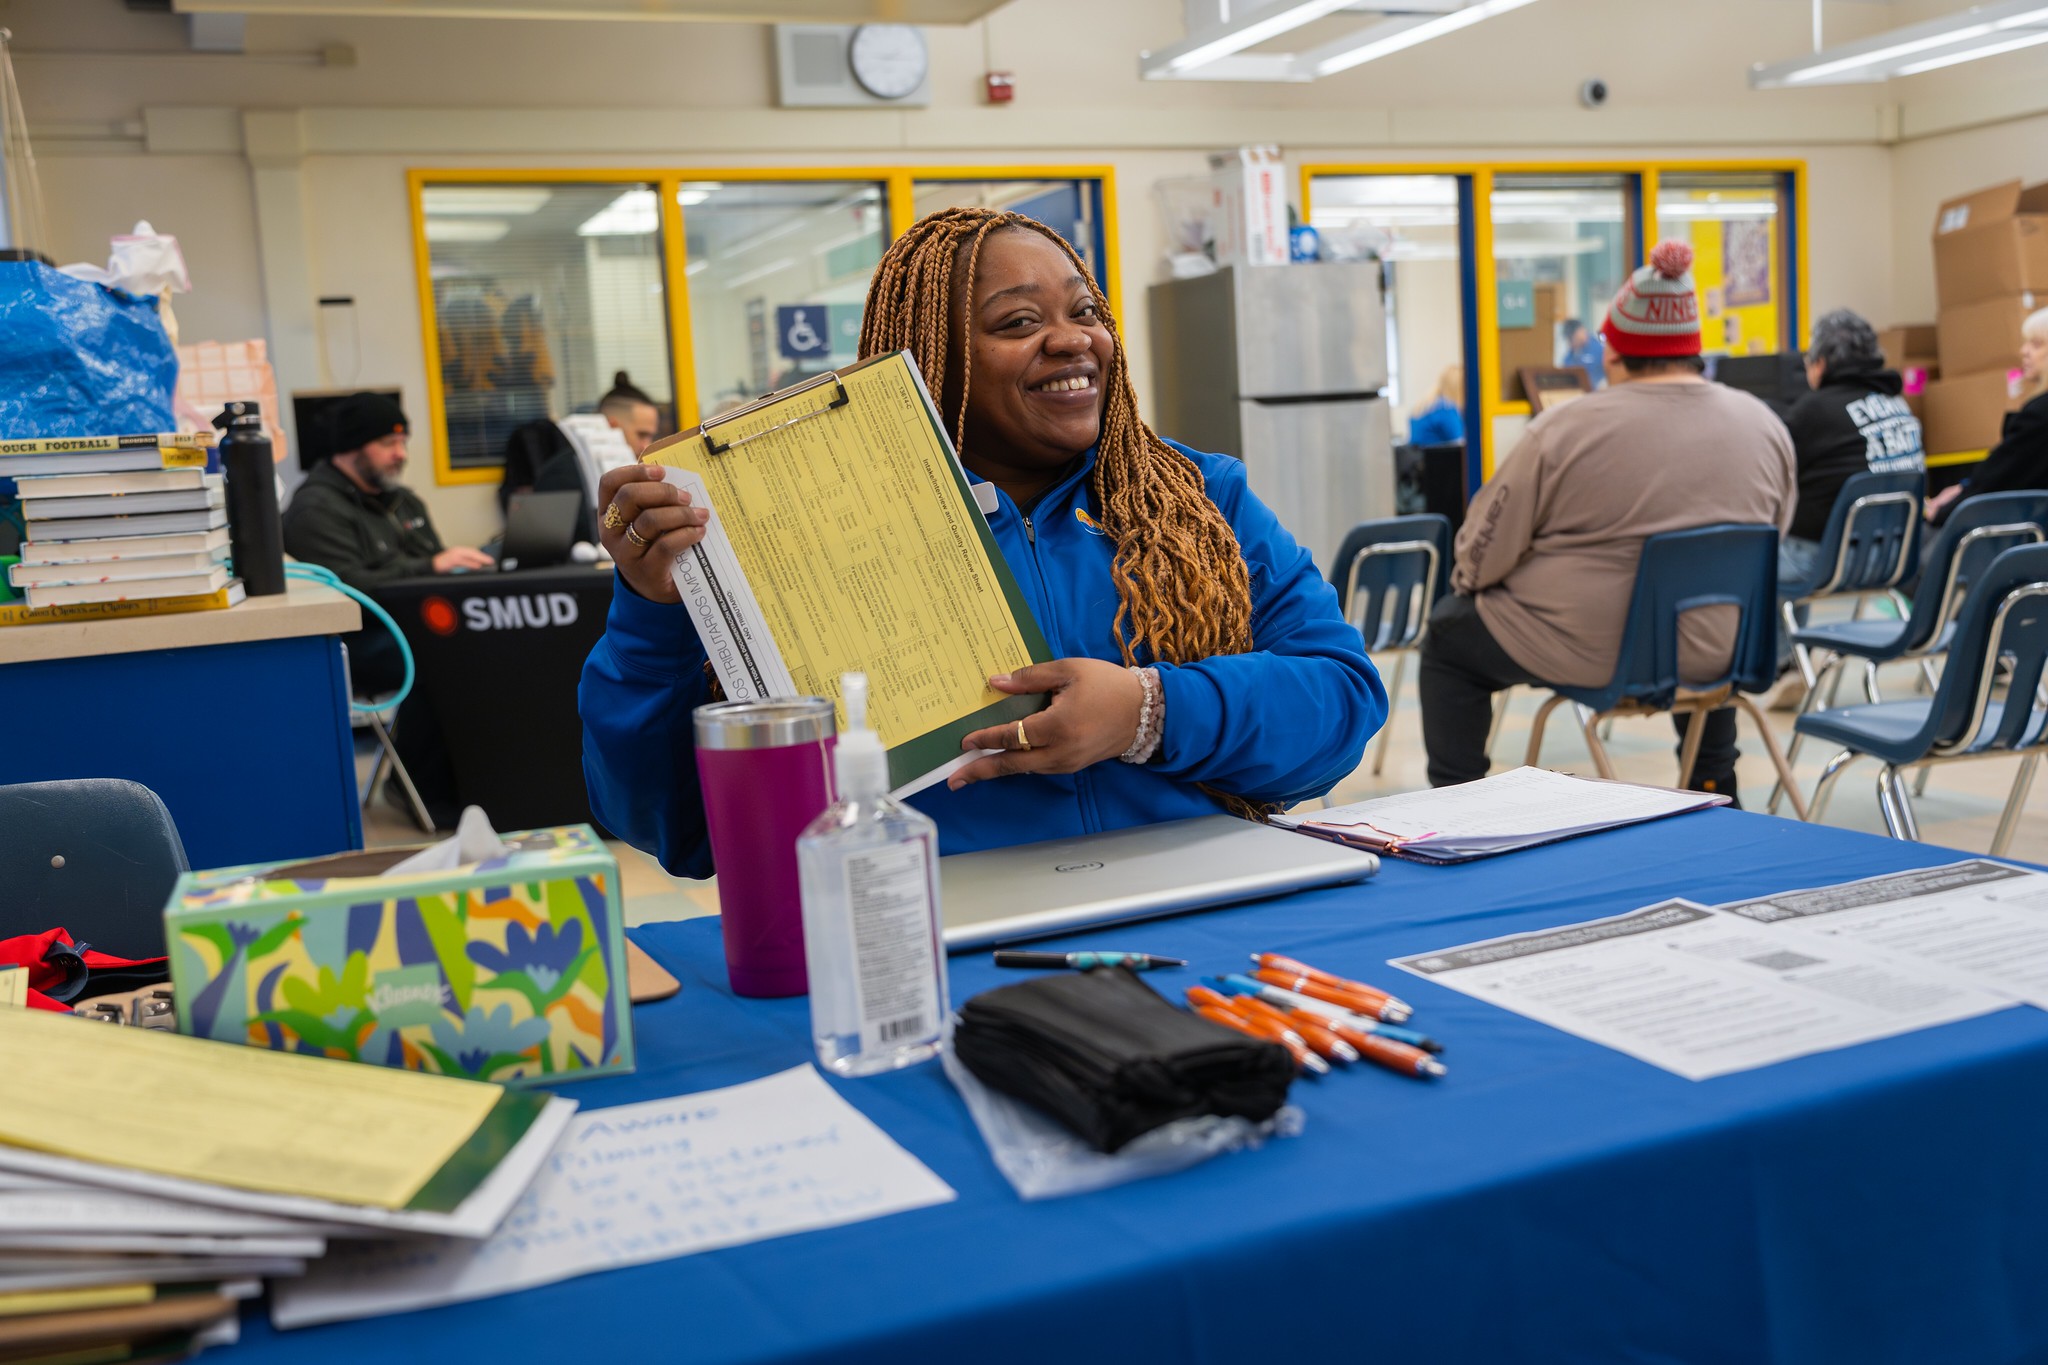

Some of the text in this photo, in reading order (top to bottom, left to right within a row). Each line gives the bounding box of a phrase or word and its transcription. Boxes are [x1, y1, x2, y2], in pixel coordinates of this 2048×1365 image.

[897, 386, 912, 409] 13614-C
[0, 439, 111, 453] OUCH FOOTBALL
[922, 458, 984, 593] Intake/Interview and Quality Review Sheet
[673, 551, 702, 595] IMPOR
[462, 592, 579, 631] SMUD
[725, 589, 752, 641] AÑO TRIBUTARIO:
[730, 676, 751, 702] OS
